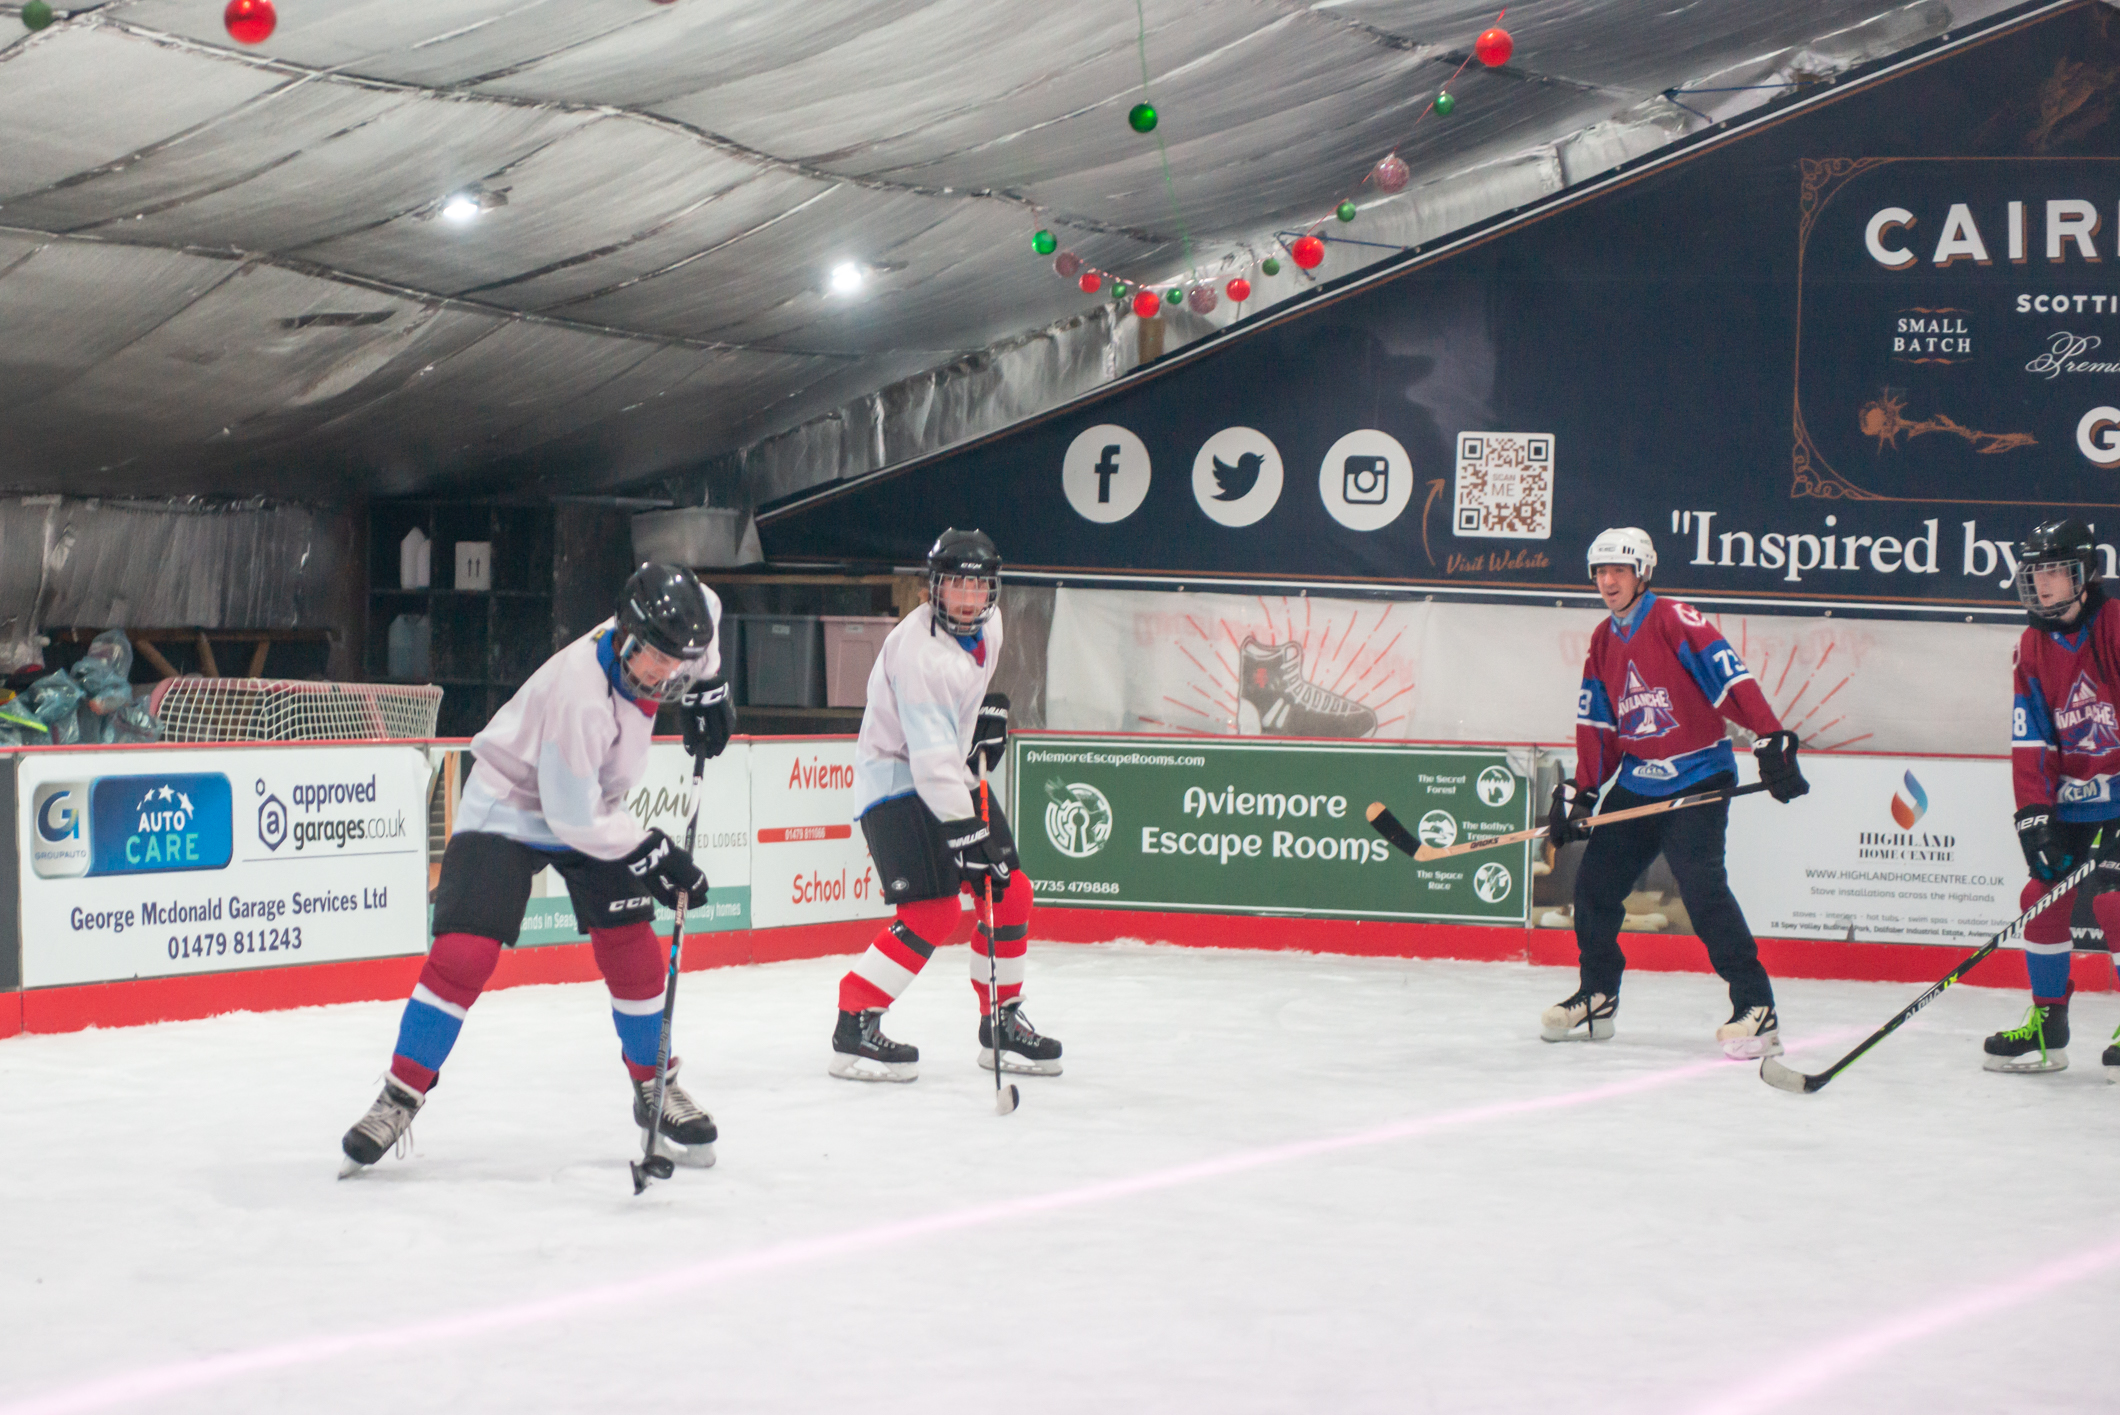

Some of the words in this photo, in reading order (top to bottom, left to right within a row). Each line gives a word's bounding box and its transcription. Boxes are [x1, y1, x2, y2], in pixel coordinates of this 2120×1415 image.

[1865, 199, 2120, 270] CAIR
[2015, 294, 2118, 314] SCOTTI
[1897, 318, 1968, 333] SMALL
[1893, 337, 1971, 353] BATCH
[1492, 473, 1516, 482] SCAN
[1491, 483, 1515, 497] ME
[1671, 509, 1940, 581] "Inspired
[1963, 520, 2015, 590] by
[1446, 552, 1484, 574] Visit
[1488, 549, 1551, 572] Website
[1027, 750, 1206, 767] AviemoreEscapeRooms.com
[788, 755, 854, 791] Aviemo
[1418, 774, 1434, 783] The
[1436, 775, 1466, 784] Secret
[293, 773, 376, 813] approved
[1426, 785, 1457, 795] Forest
[1183, 784, 1348, 820] Aviemore
[138, 810, 186, 833] AUTO
[293, 808, 406, 850] garages.co.uk
[1462, 821, 1479, 830] The
[125, 832, 200, 864] CARE
[713, 832, 748, 848] LODGES
[1141, 826, 1262, 865] Escape
[1272, 830, 1390, 865] Rooms
[1859, 831, 1956, 848] HIGHLAND
[34, 849, 87, 861] GROUPAUTO
[1859, 847, 1898, 860] HOME
[1900, 848, 1954, 862] CENTRE
[1417, 870, 1433, 879] The
[1435, 871, 1464, 881] Space
[1805, 868, 2005, 887] WWW.HIGHLANDHOMECENTRE.CO.UK
[792, 867, 846, 904] School
[854, 866, 872, 901] of
[1067, 881, 1120, 894] 479888
[1428, 880, 1451, 891] Race
[1810, 886, 1836, 896] Stove
[1838, 887, 1895, 899] installations
[1898, 890, 1928, 900] across
[1930, 891, 1946, 901] the
[1948, 892, 1995, 904] Highlands
[70, 906, 135, 933] George
[141, 897, 222, 926] Mcdonald
[229, 896, 286, 922] Garage
[291, 890, 358, 915] Services
[363, 886, 388, 910] Ltd
[1908, 915, 1928, 923] swim
[1781, 921, 1797, 930] Spey
[1799, 922, 1821, 931] Valley
[1906, 927, 1939, 936] Industrial
[168, 932, 227, 960] 01479
[233, 926, 303, 954] 811243
